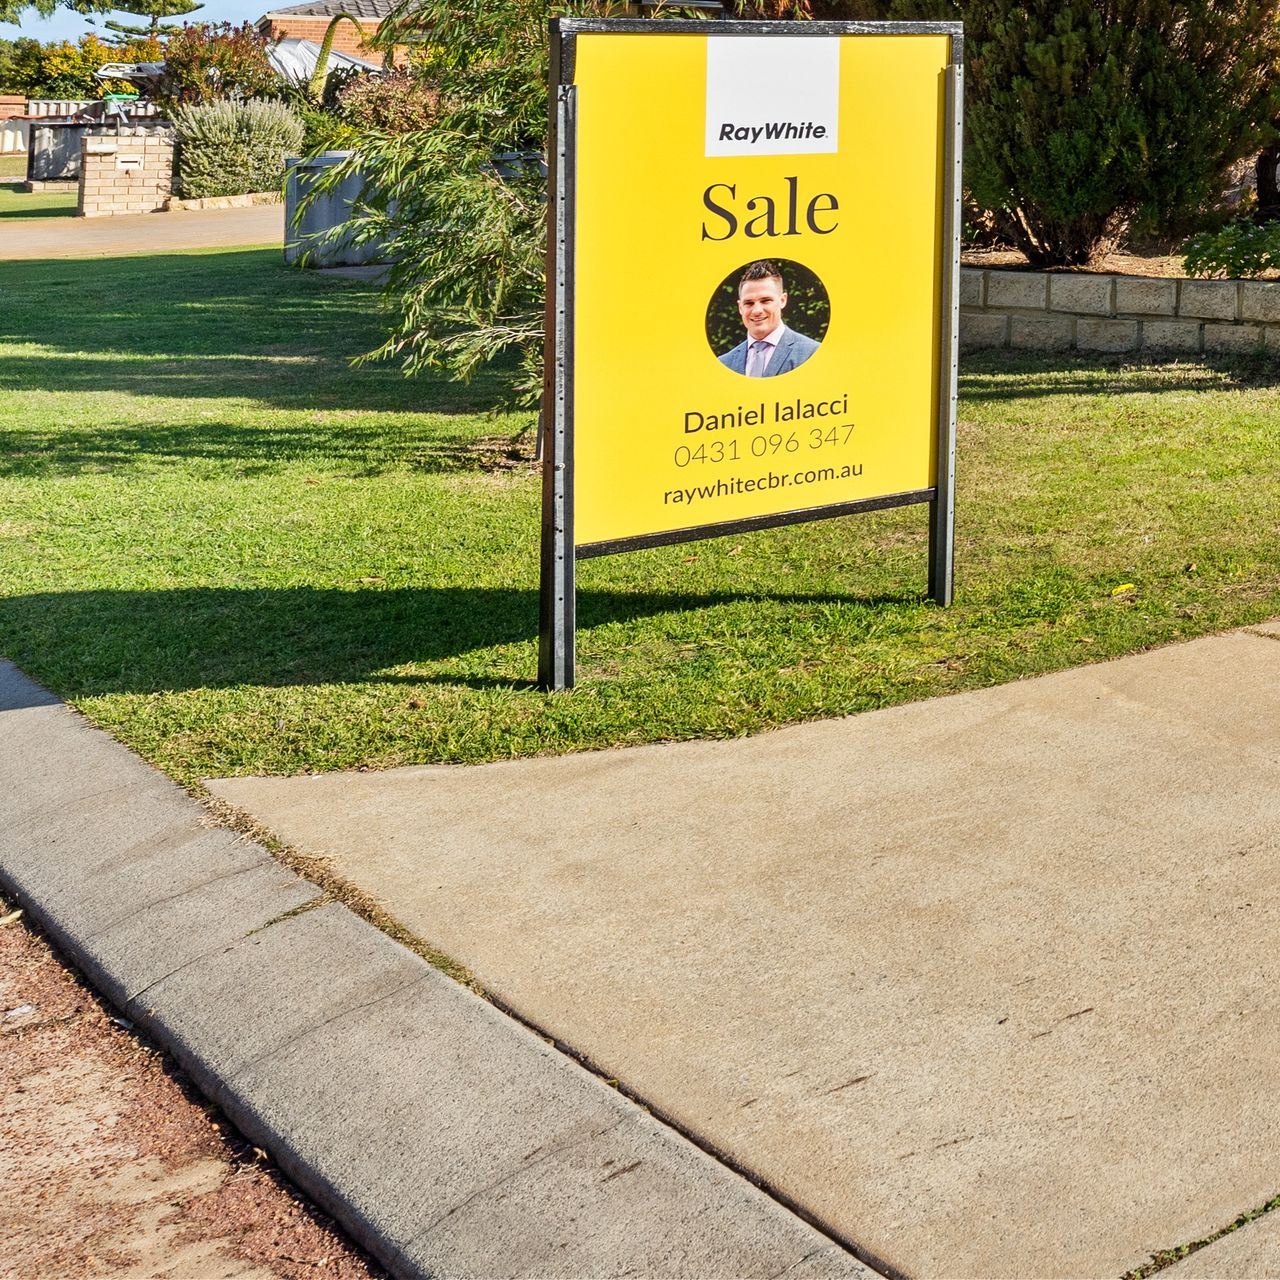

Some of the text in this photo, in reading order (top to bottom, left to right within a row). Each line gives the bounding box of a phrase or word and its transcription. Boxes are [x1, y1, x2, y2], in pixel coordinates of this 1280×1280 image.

[701, 176, 839, 241] Sale
[684, 403, 765, 434] Daniel
[674, 423, 855, 468] 0431 096 347
[663, 463, 864, 505] raywhitecbr.com.au
